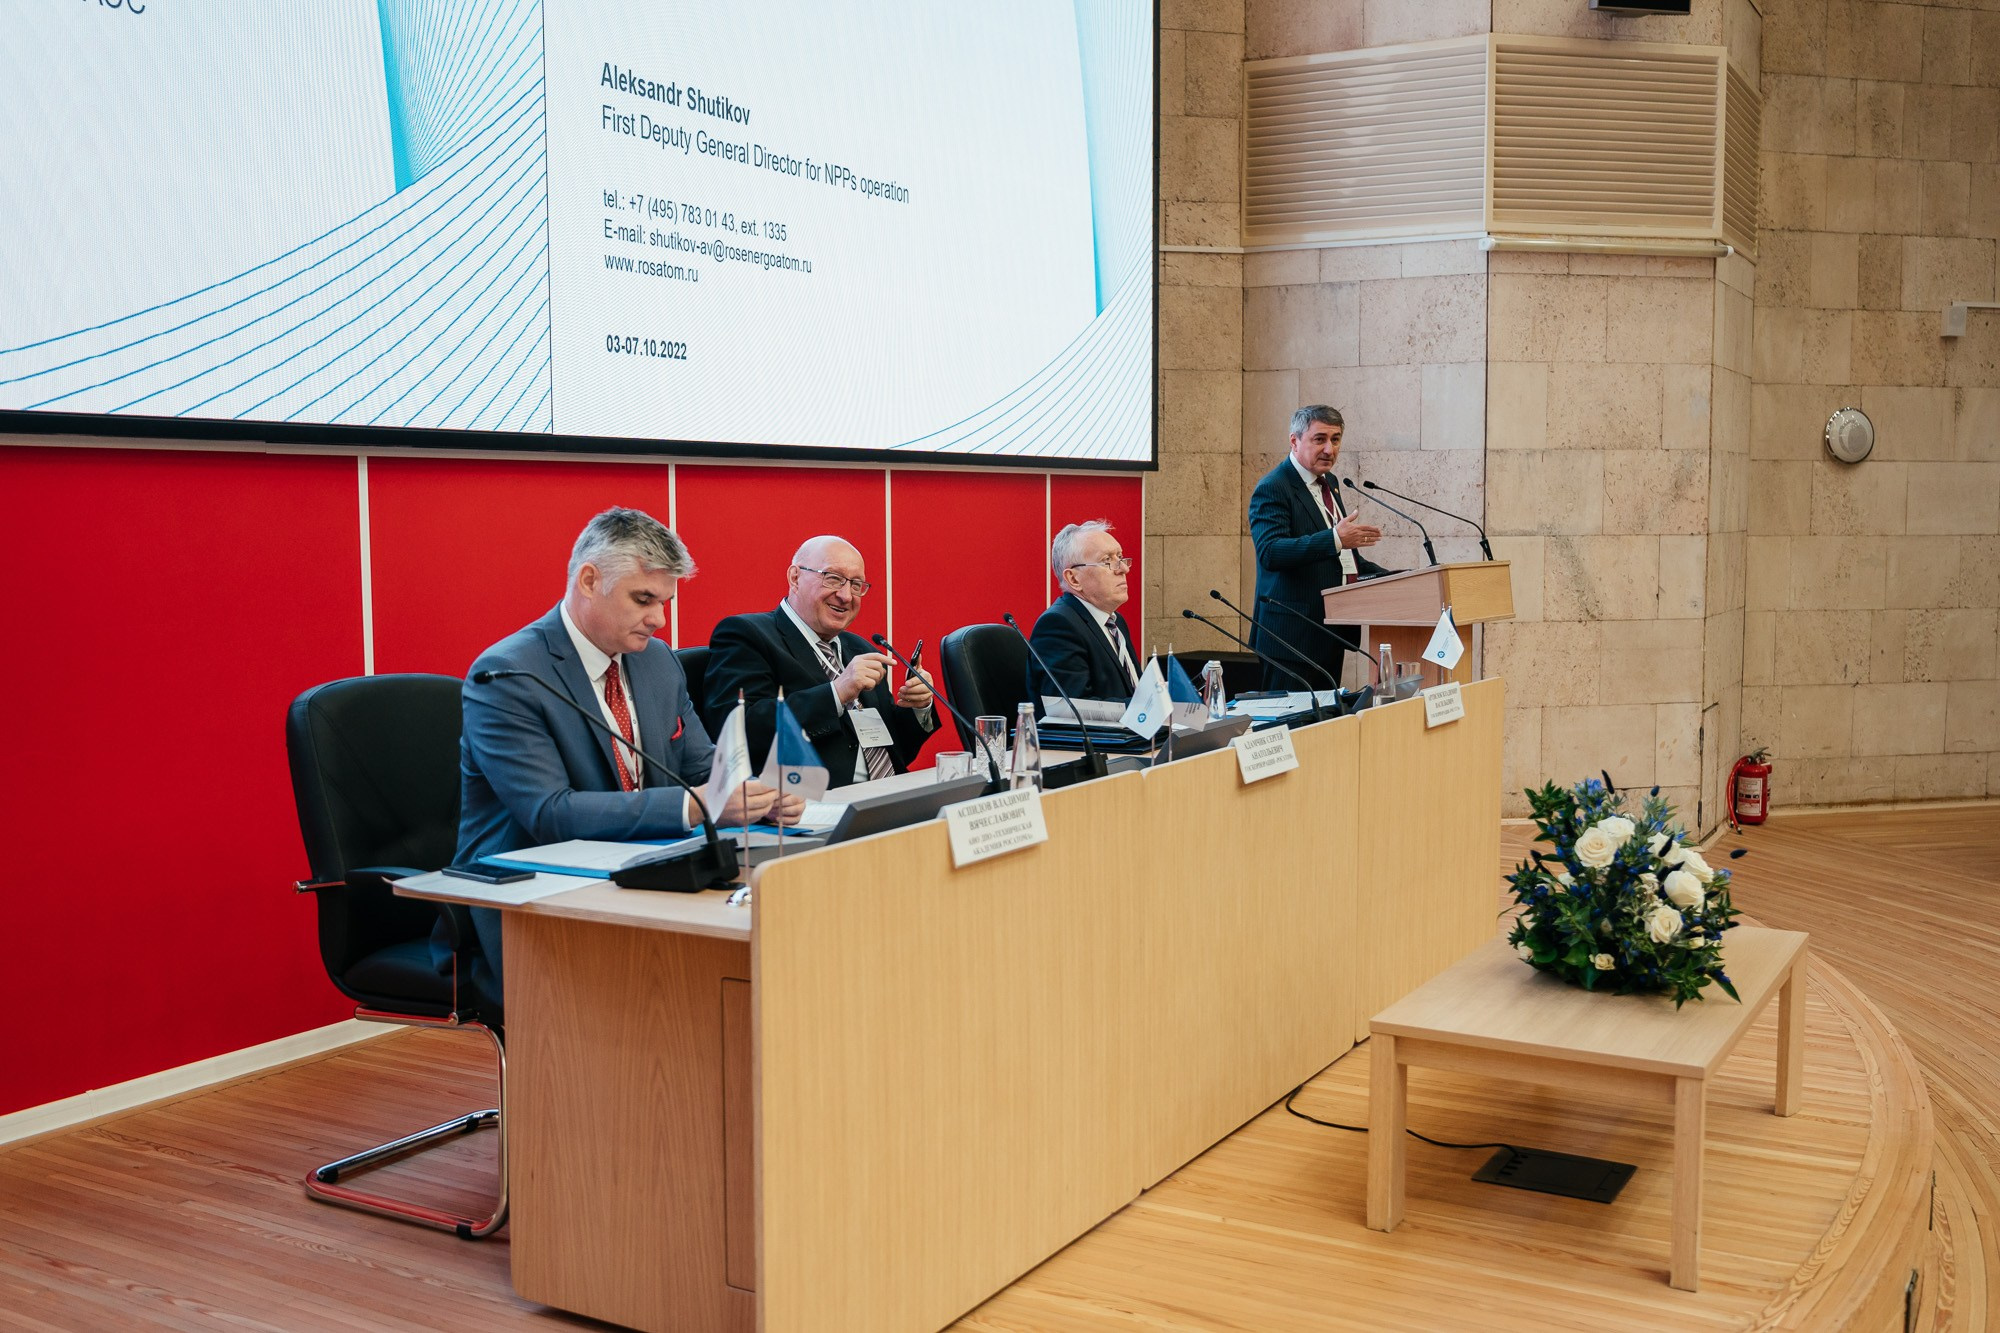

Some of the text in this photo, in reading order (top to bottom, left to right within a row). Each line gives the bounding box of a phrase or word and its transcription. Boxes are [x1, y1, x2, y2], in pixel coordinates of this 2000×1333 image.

[601, 62, 750, 126] Aleksandr Shutikov
[602, 104, 910, 204] First Deputy General Director for NPPs operation
[603, 189, 787, 242] tel.: +7 (495) 783 01 43, ext. 1335
[604, 218, 812, 274] E-mail: shutikov-av@rosenergoatom.ru
[604, 254, 699, 283] www.rosatom.ru
[606, 334, 687, 360] 03-07.10.2022
[969, 807, 1026, 831] ВЯЧЕСЛАВОВИЧ
